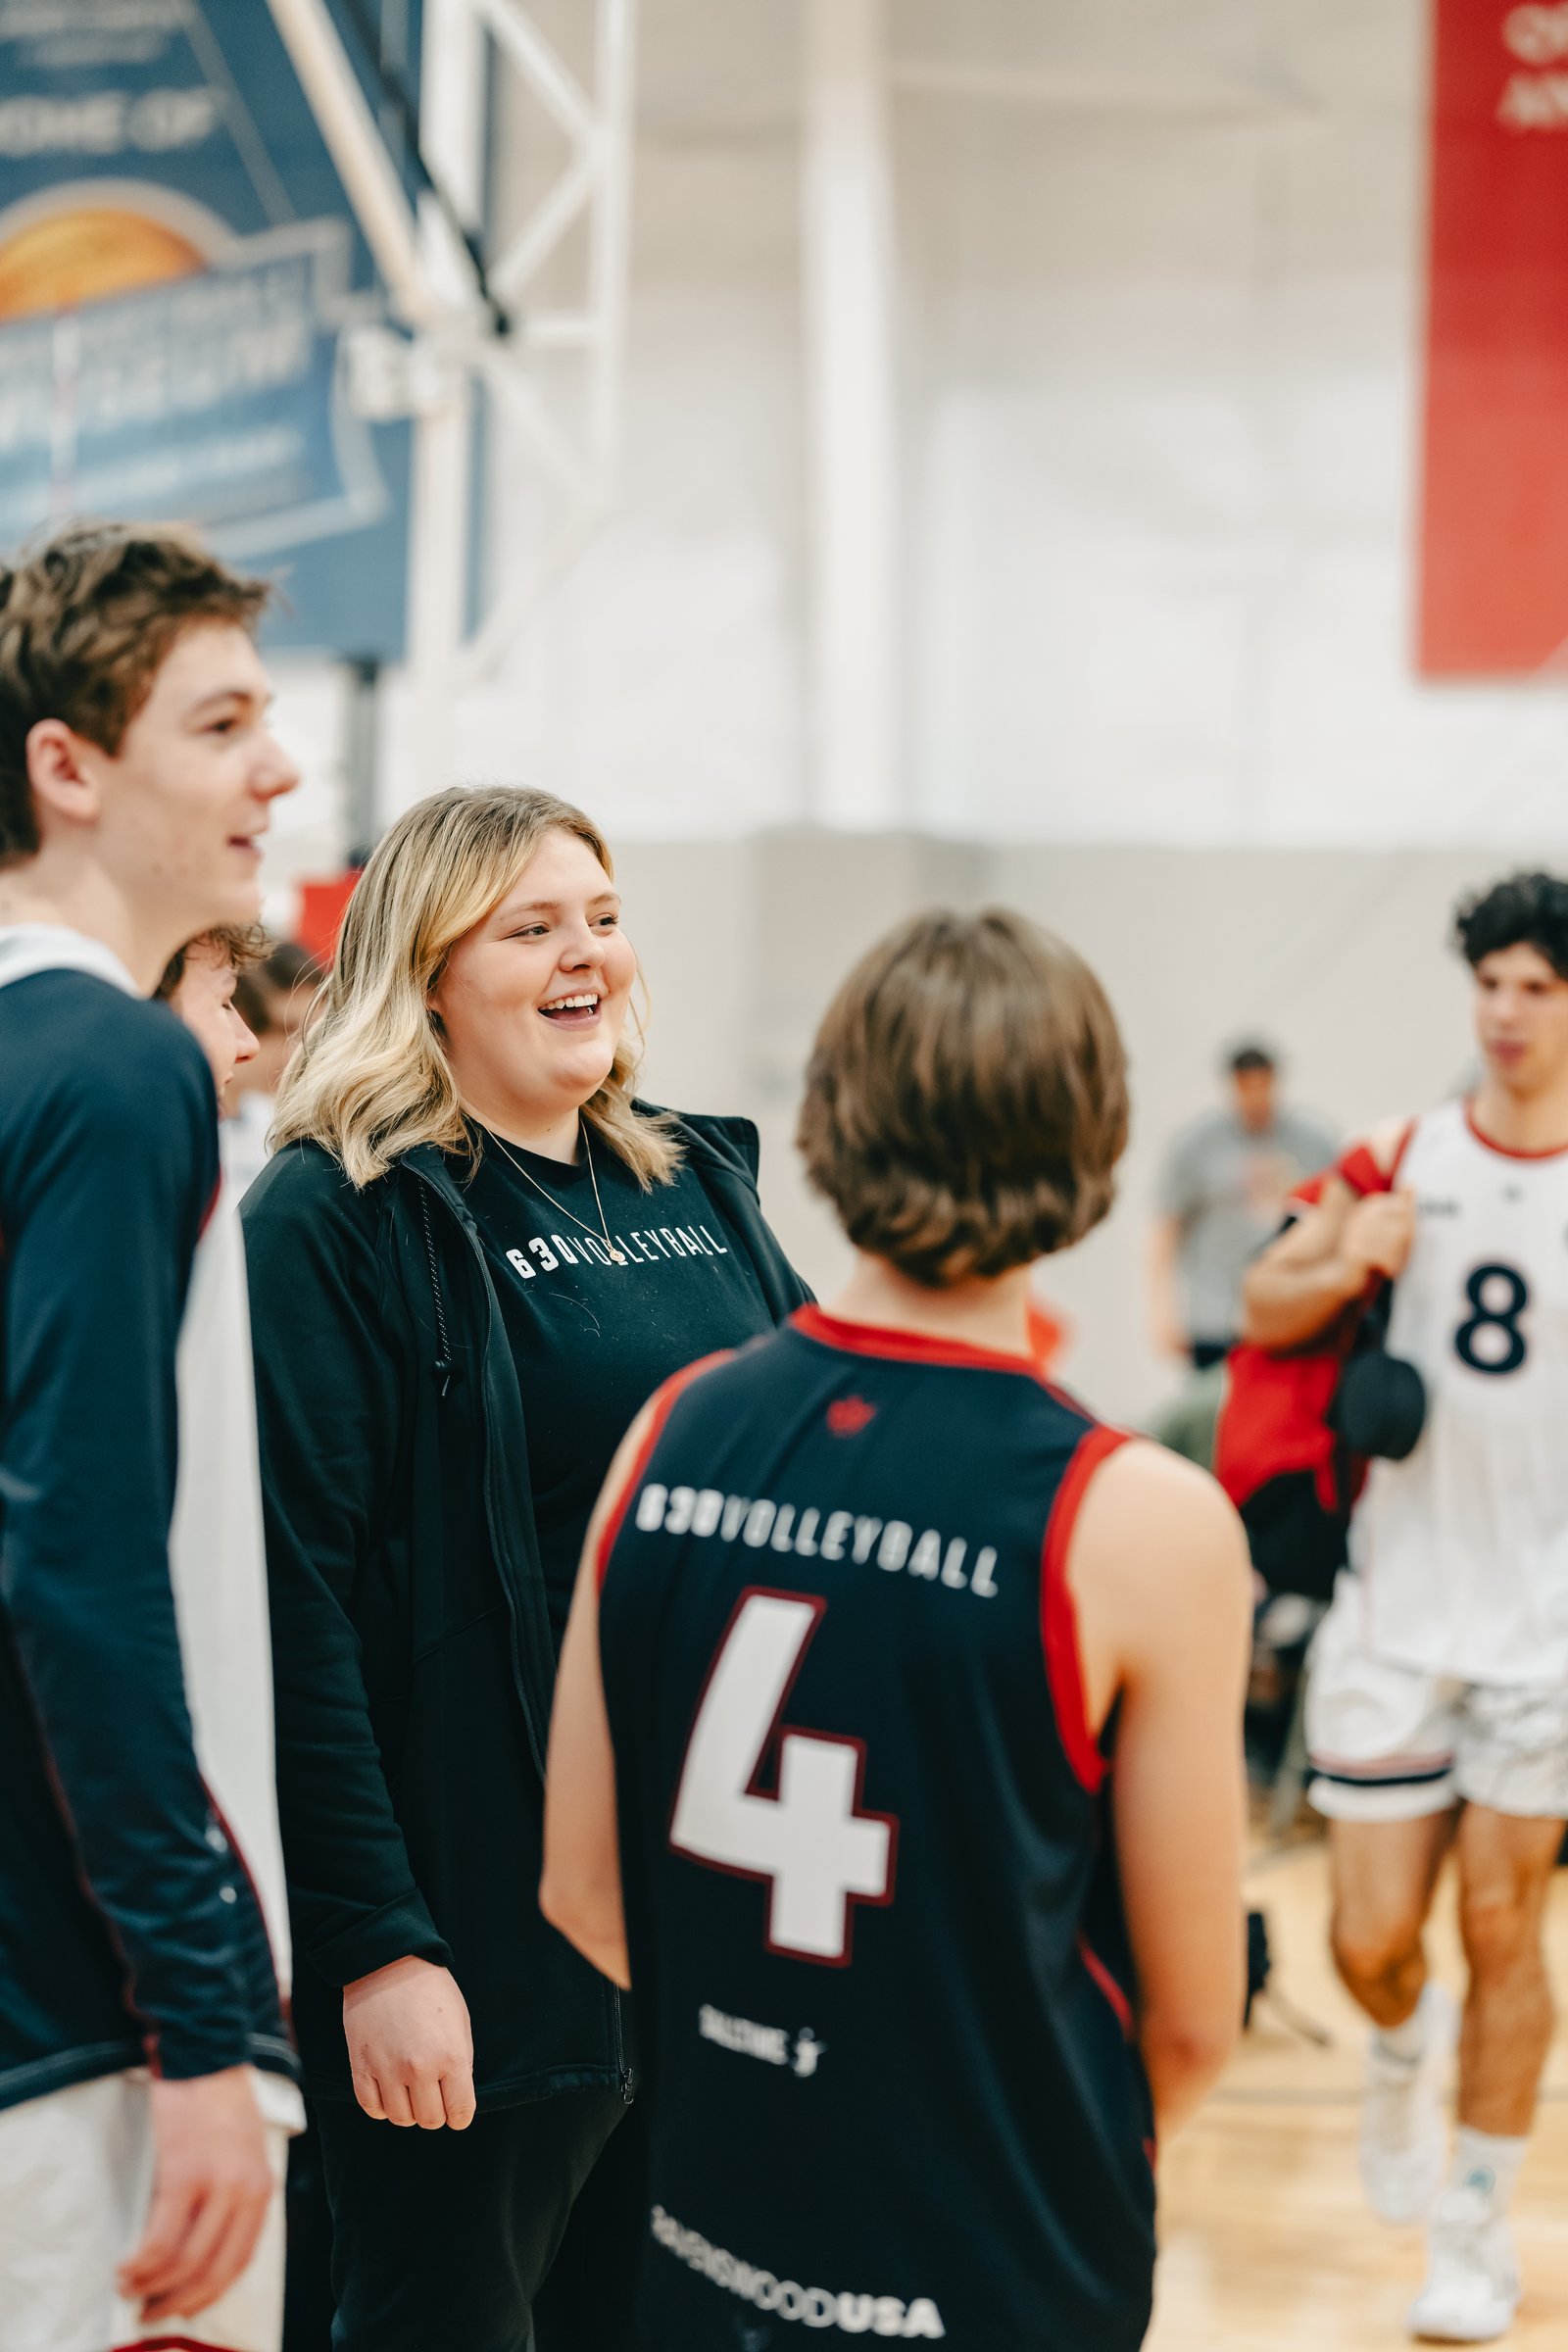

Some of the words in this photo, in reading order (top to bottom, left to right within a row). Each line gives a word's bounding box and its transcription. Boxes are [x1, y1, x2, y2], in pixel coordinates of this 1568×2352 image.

[506, 1225, 727, 1279] 630VOLLEYBALL
[1455, 1263, 1528, 1374] 8
[669, 1585, 901, 1969] 4
